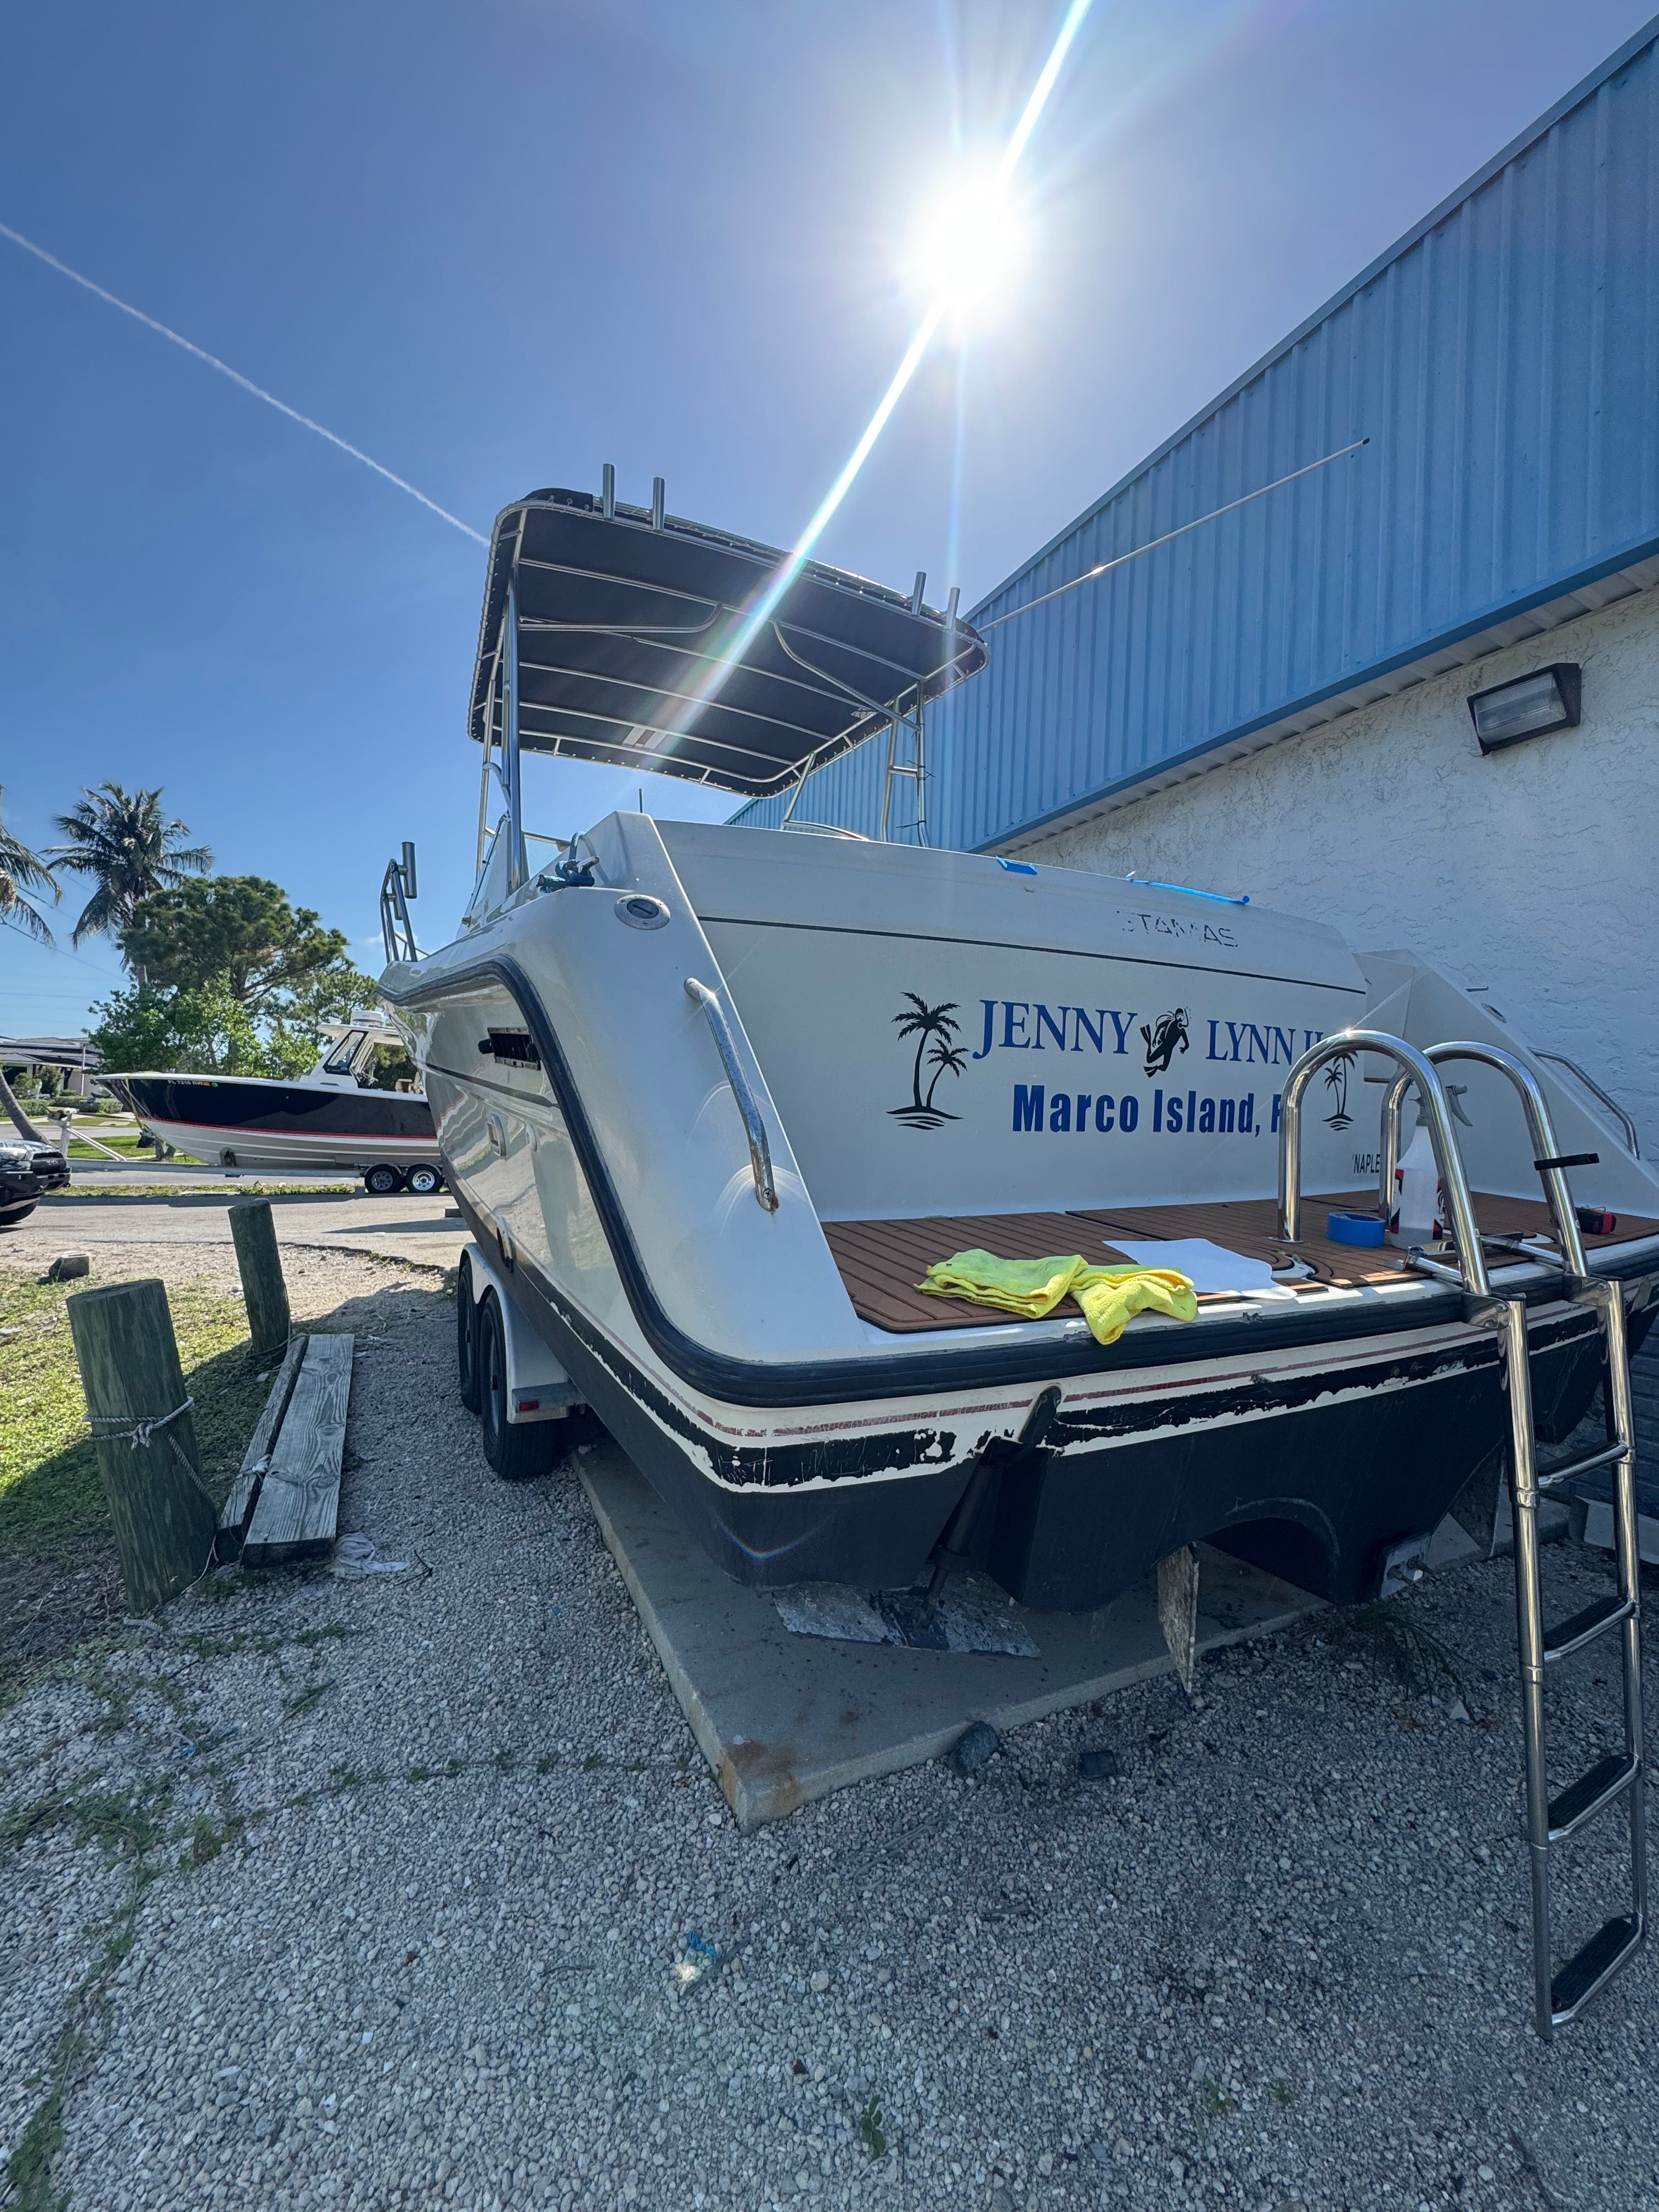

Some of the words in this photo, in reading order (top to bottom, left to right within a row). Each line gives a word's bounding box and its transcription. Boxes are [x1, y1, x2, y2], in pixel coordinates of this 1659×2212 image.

[1116, 911, 1238, 947] TAMAS
[972, 999, 1138, 1060] JENNY
[1205, 1019, 1296, 1066] LYNN
[1012, 1084, 1139, 1132] Marco
[1152, 1089, 1260, 1137] Island,
[1270, 1093, 1282, 1133] F
[1353, 1154, 1381, 1173] NAPLE
